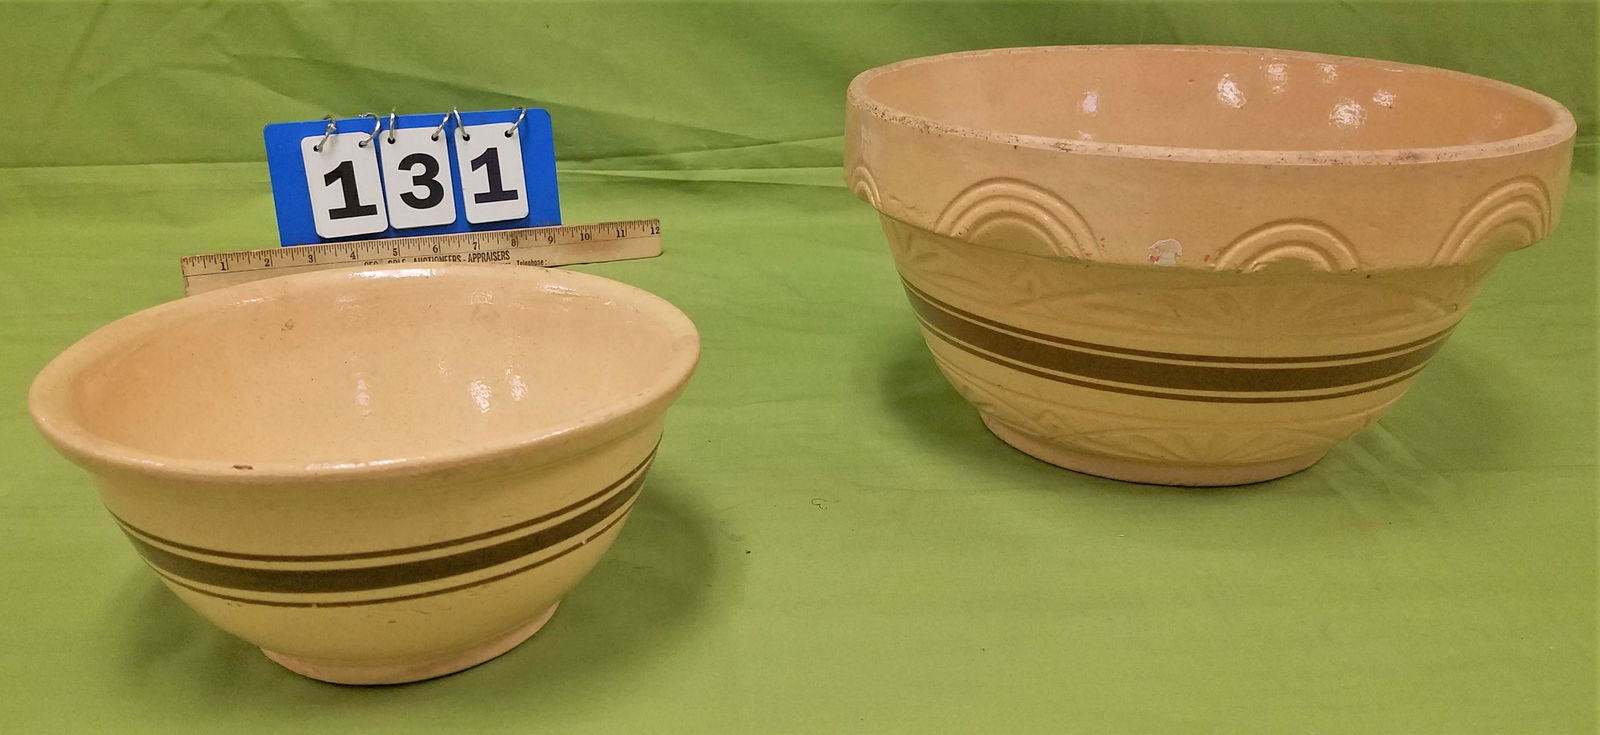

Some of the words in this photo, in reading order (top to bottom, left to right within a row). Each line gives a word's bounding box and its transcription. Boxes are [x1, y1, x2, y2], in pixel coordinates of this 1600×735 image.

[221, 261, 226, 270] 1
[264, 258, 270, 267] 2
[307, 254, 314, 263] 3
[349, 251, 356, 260] 4
[392, 248, 398, 256] 5
[432, 244, 439, 253] 6
[472, 241, 478, 250] 7
[511, 238, 516, 247] 8
[548, 235, 553, 244] 9
[580, 232, 590, 241] 10
[616, 229, 625, 238] 11
[650, 226, 660, 235] 12
[467, 250, 511, 263] APPRAISERS
